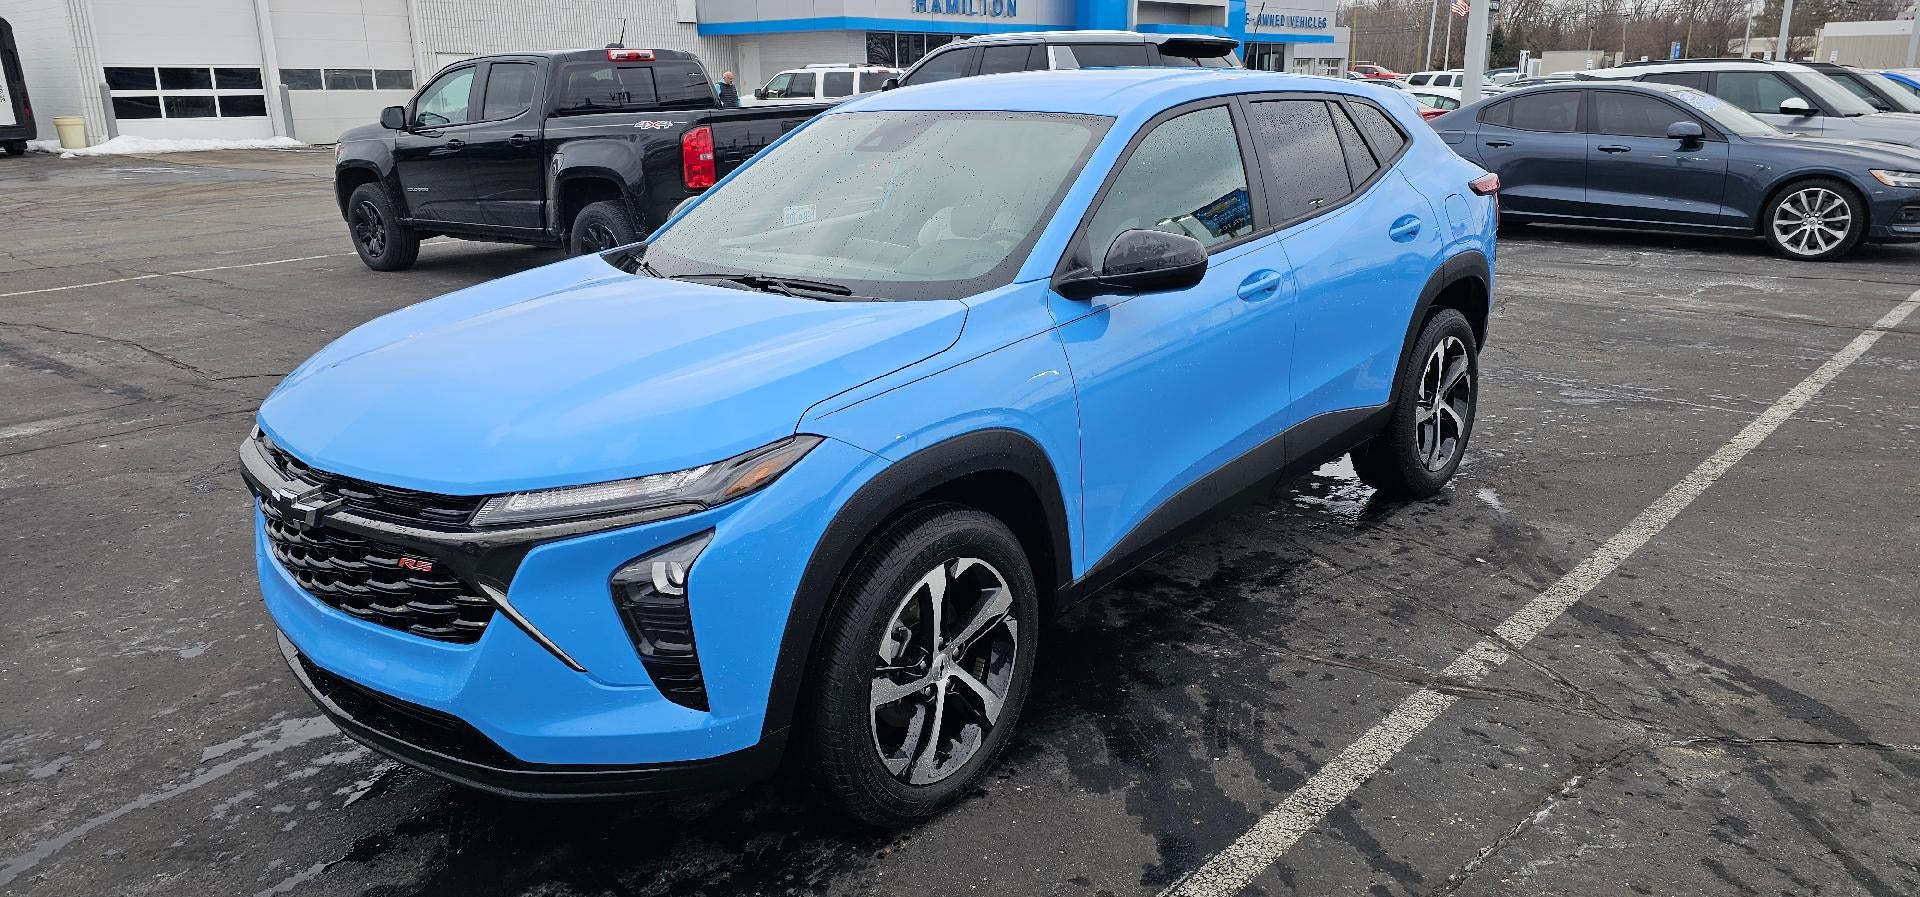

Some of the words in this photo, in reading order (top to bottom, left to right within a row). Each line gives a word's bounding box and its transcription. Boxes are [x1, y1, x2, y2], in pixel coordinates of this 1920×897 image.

[913, 0, 1017, 17] HAMILTON
[1245, 13, 1285, 27] E-OWNED
[1289, 15, 1327, 29] VEHICLES
[398, 557, 433, 572] RS
